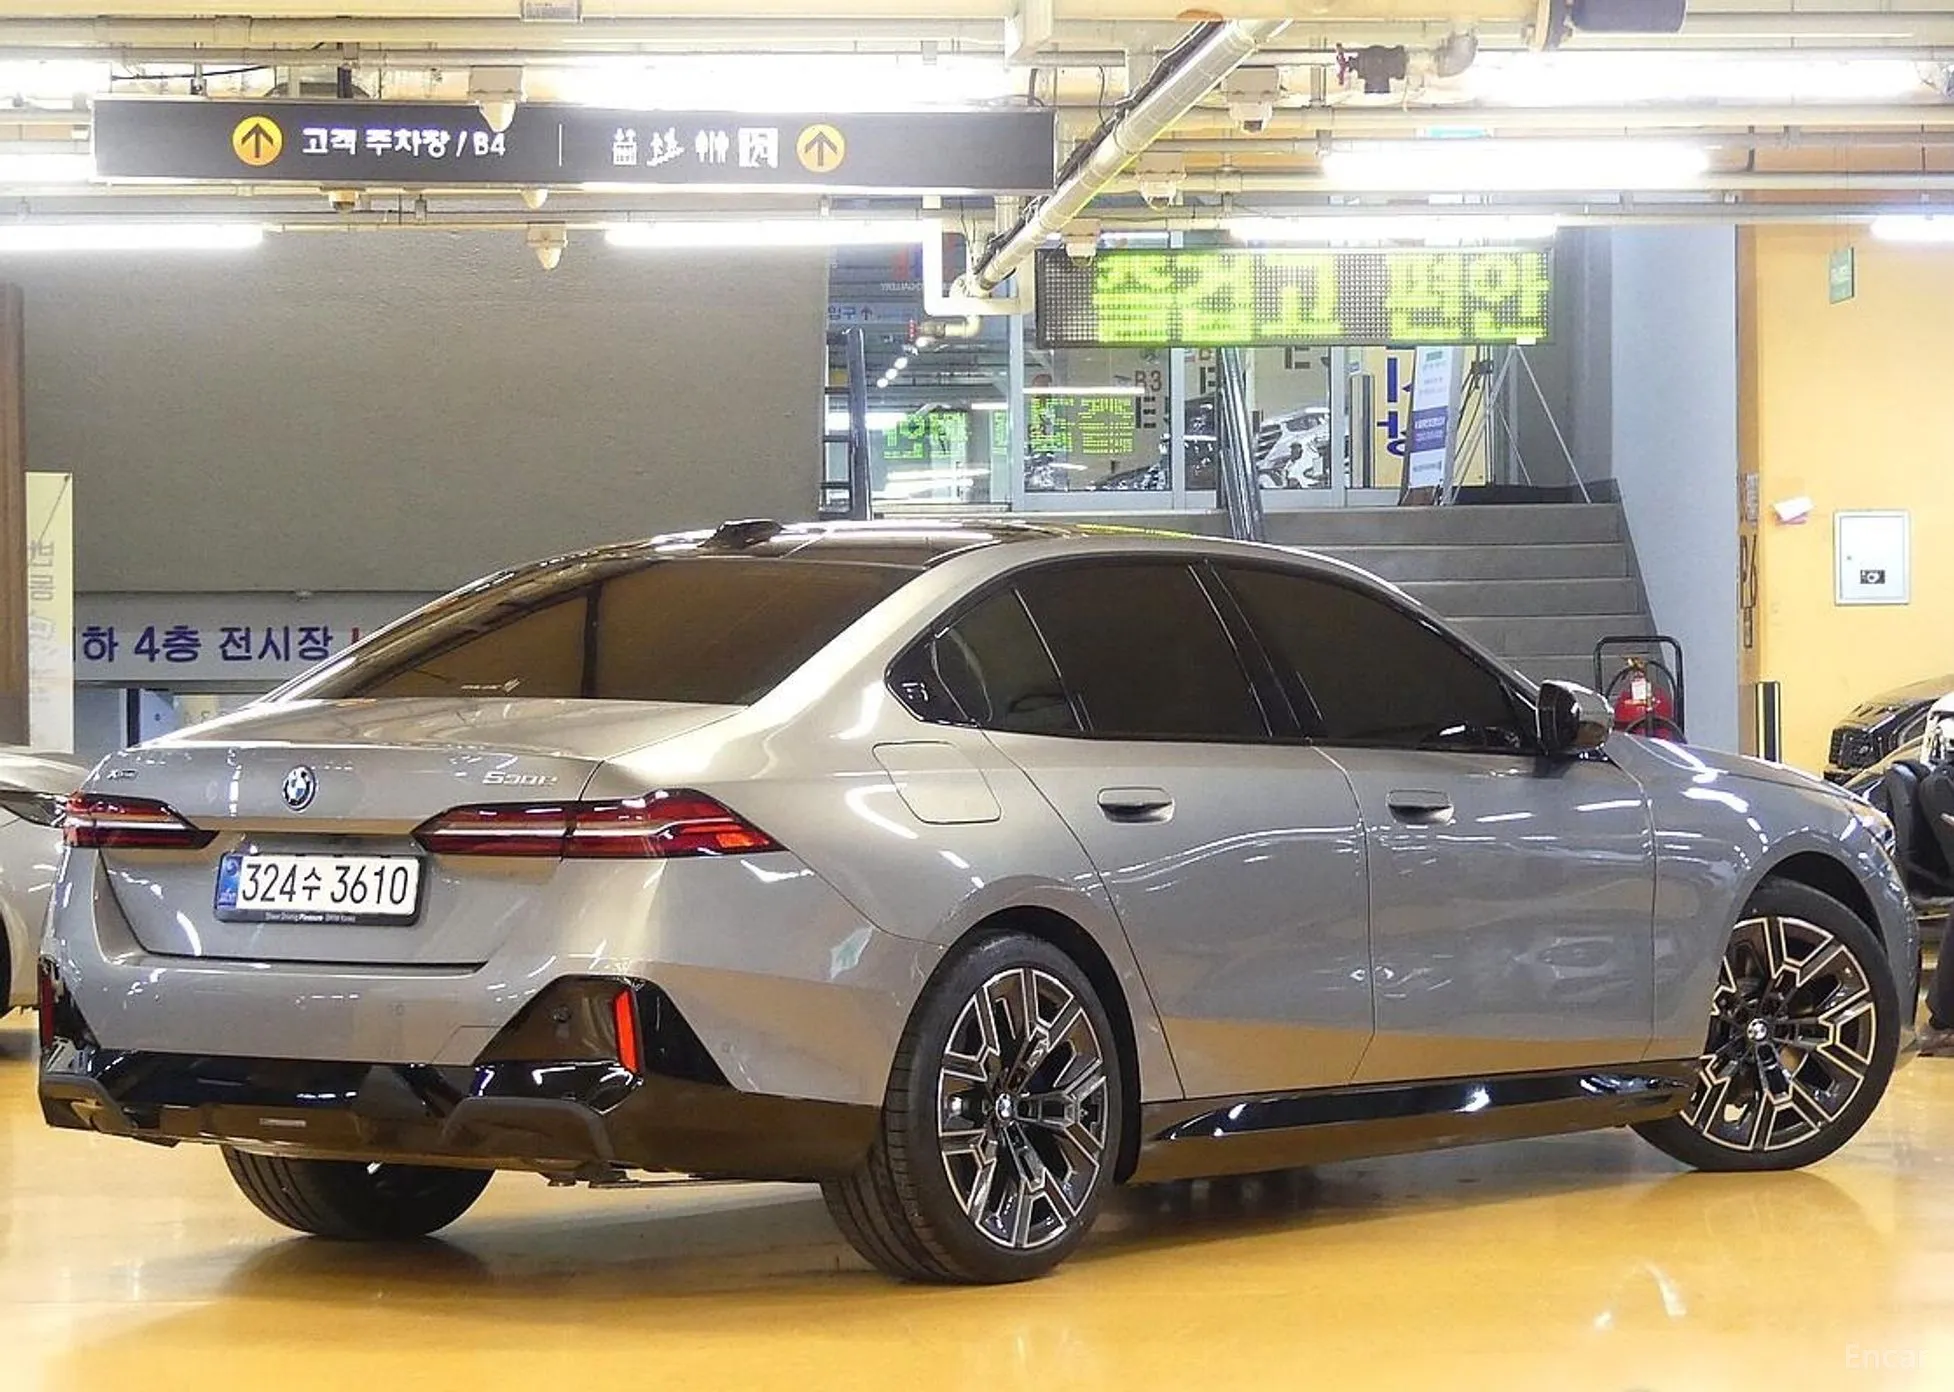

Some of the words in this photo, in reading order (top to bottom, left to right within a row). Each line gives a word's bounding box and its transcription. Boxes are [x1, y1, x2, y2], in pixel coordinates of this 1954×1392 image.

[302, 127, 357, 155] 고객
[365, 127, 450, 158] 주차장
[473, 131, 506, 156] B4
[1135, 370, 1162, 391] B3
[73, 625, 119, 662] 하
[134, 625, 201, 662] 4층
[219, 625, 333, 662] 전시장
[242, 863, 323, 902] 324수
[331, 864, 408, 905] 3610
